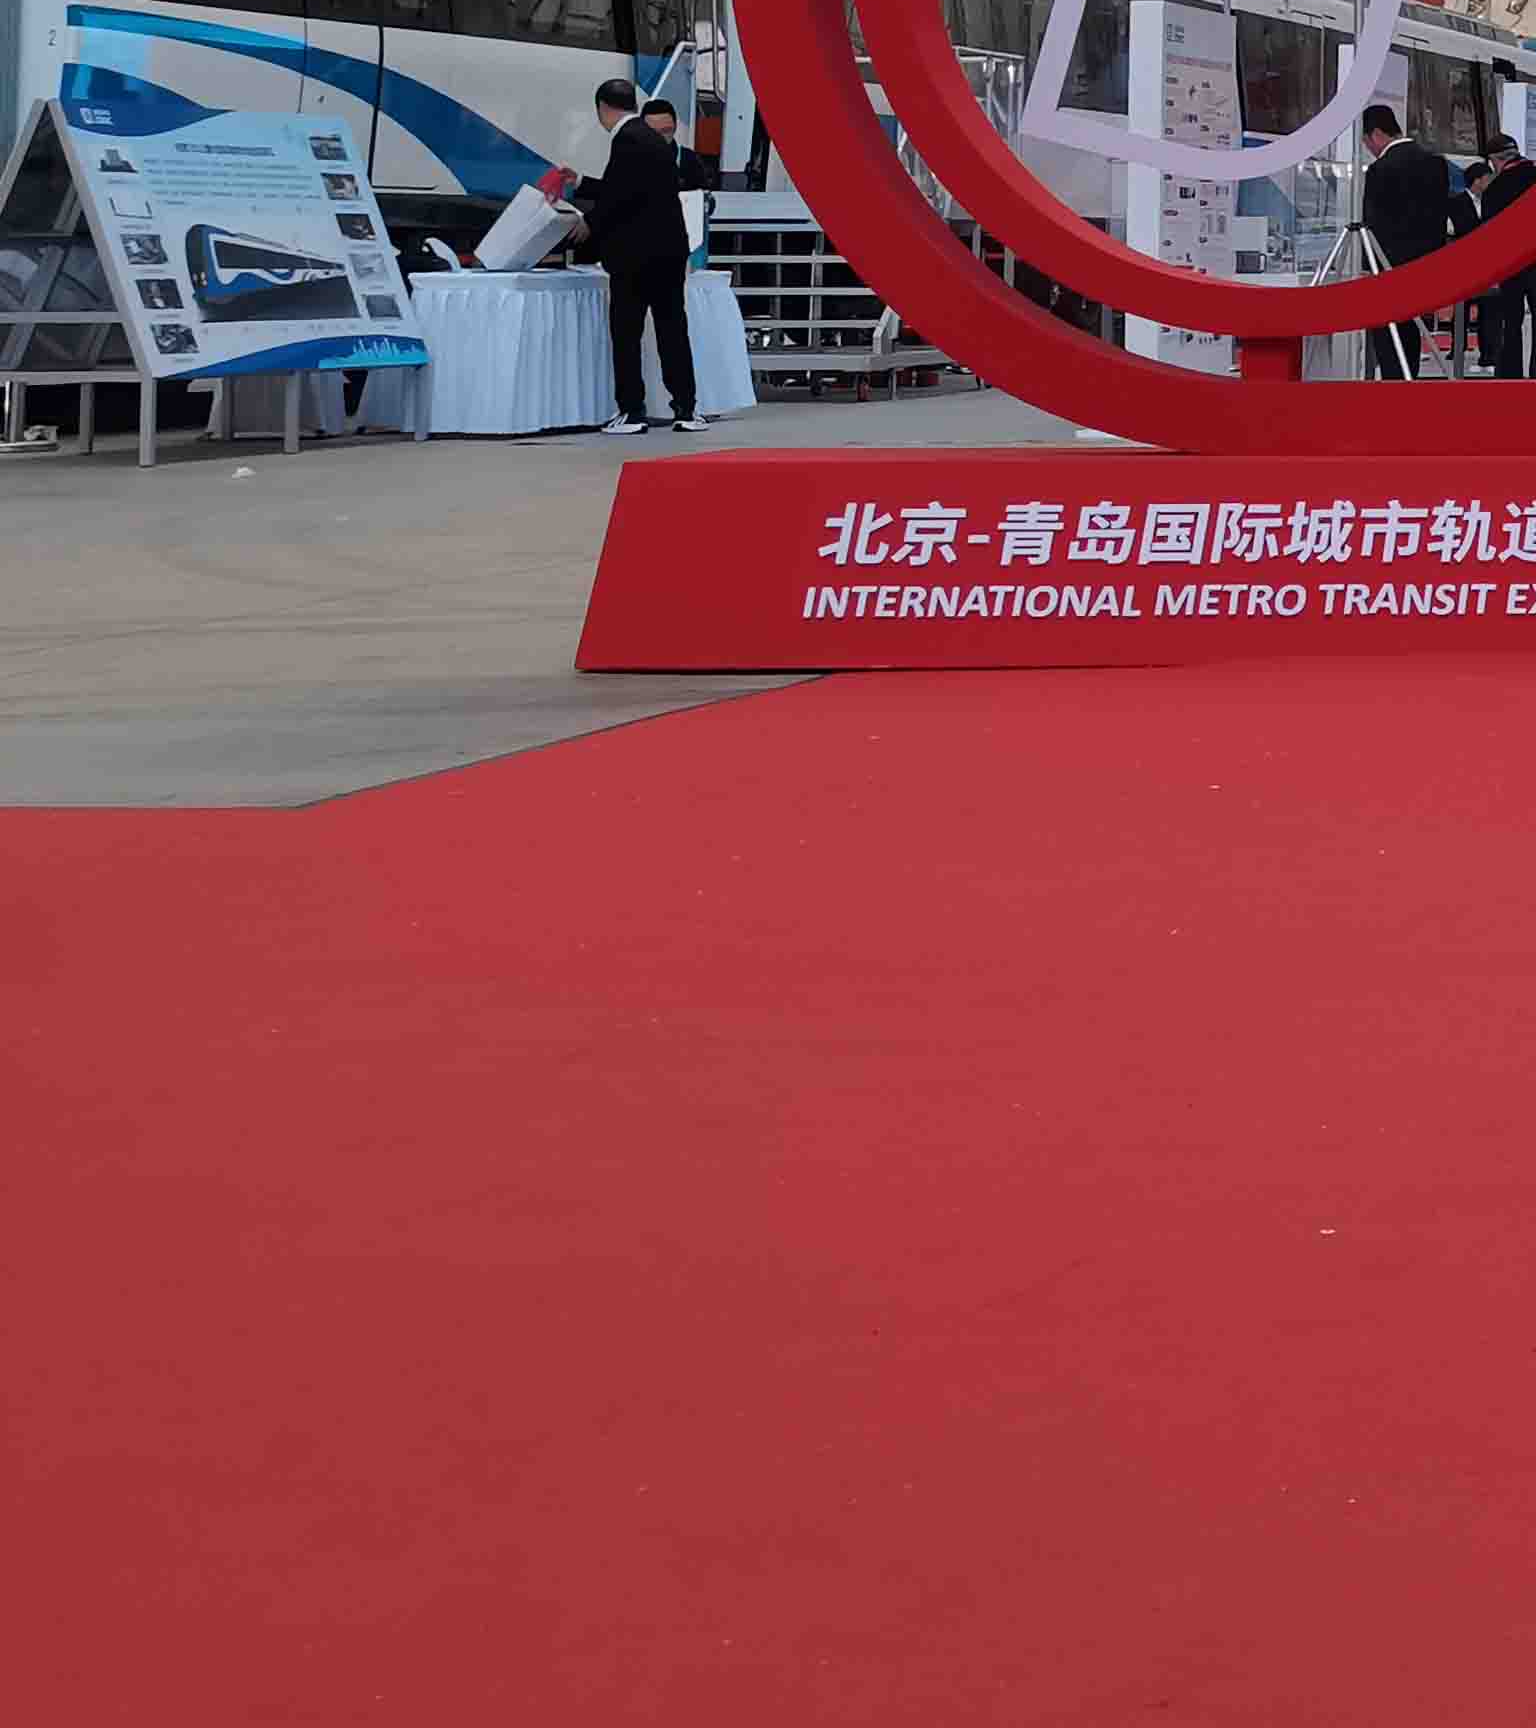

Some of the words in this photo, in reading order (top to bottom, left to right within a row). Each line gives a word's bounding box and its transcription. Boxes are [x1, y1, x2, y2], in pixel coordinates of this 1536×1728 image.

[803, 586, 1142, 619] INTERNATIONAL
[1155, 584, 1307, 616] METRO
[1319, 584, 1497, 616] TRANSIT
